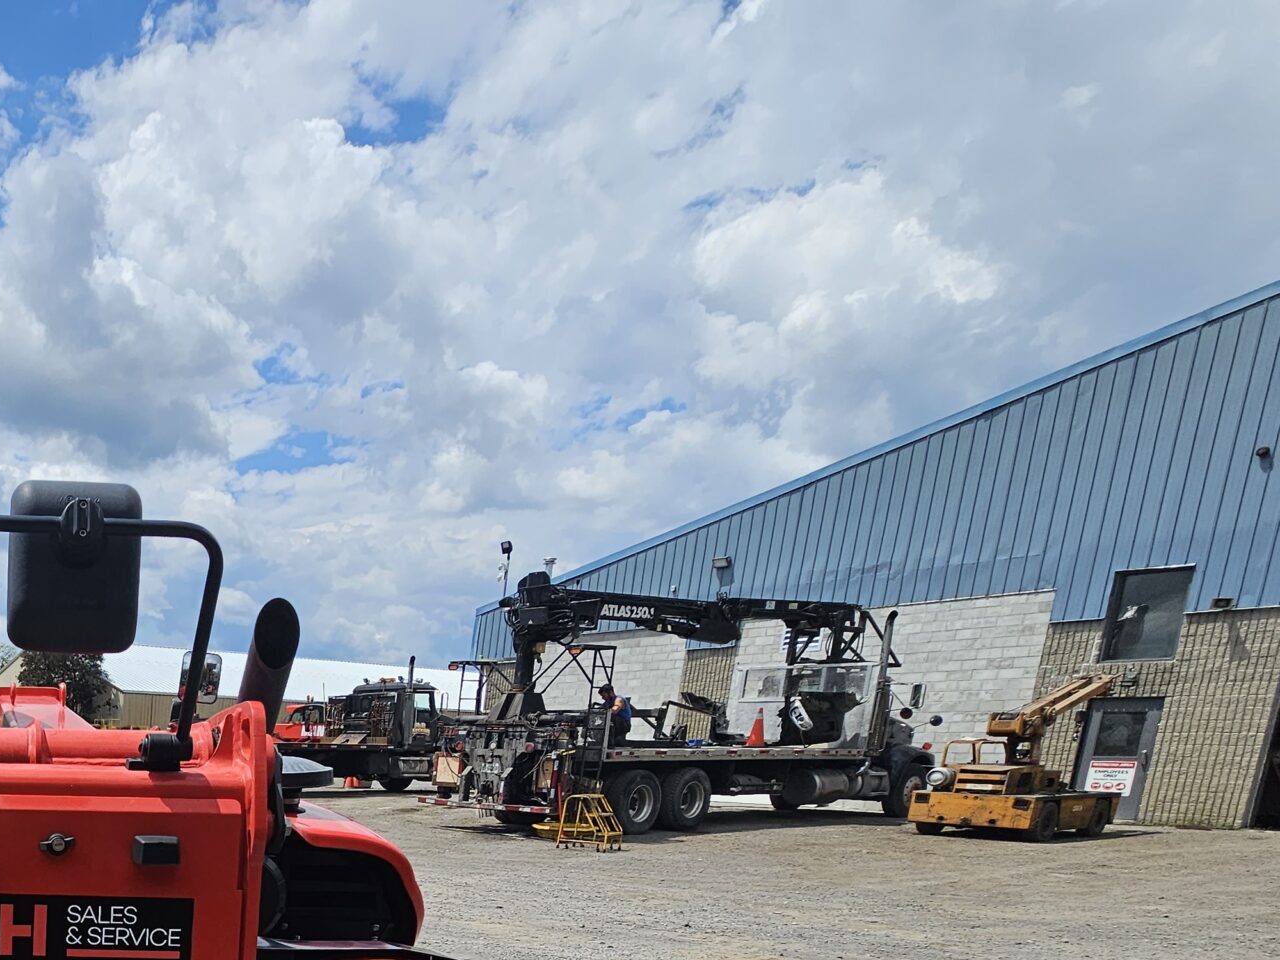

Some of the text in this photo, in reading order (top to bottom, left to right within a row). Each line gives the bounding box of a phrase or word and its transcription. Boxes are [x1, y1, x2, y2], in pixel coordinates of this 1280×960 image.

[600, 603, 631, 618] ATLAS
[66, 904, 138, 925] SALES
[65, 926, 182, 947] & SERVICE
